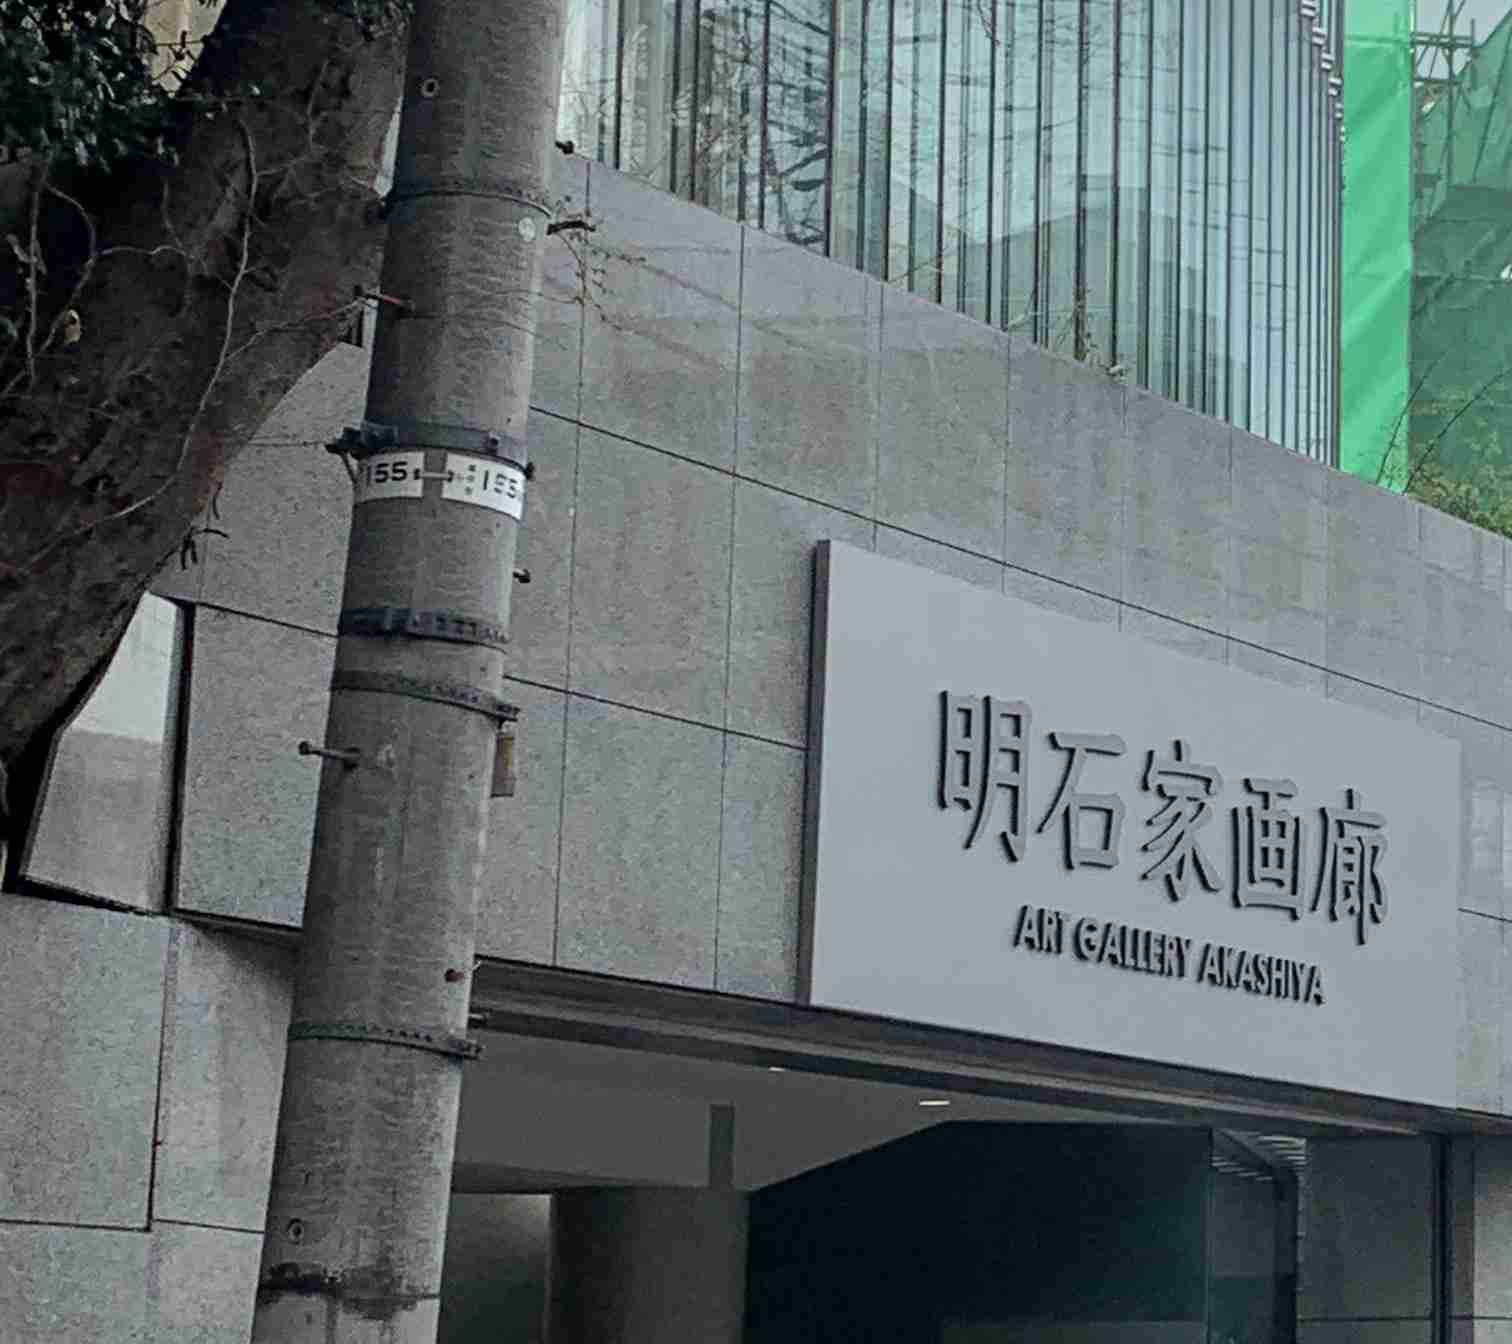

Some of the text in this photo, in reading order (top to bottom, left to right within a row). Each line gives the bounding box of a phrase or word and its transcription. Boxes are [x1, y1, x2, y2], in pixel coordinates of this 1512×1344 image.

[936, 690, 1388, 946] 明石家画廊
[1013, 904, 1325, 1006] ART GALLERY AKASHIYA
